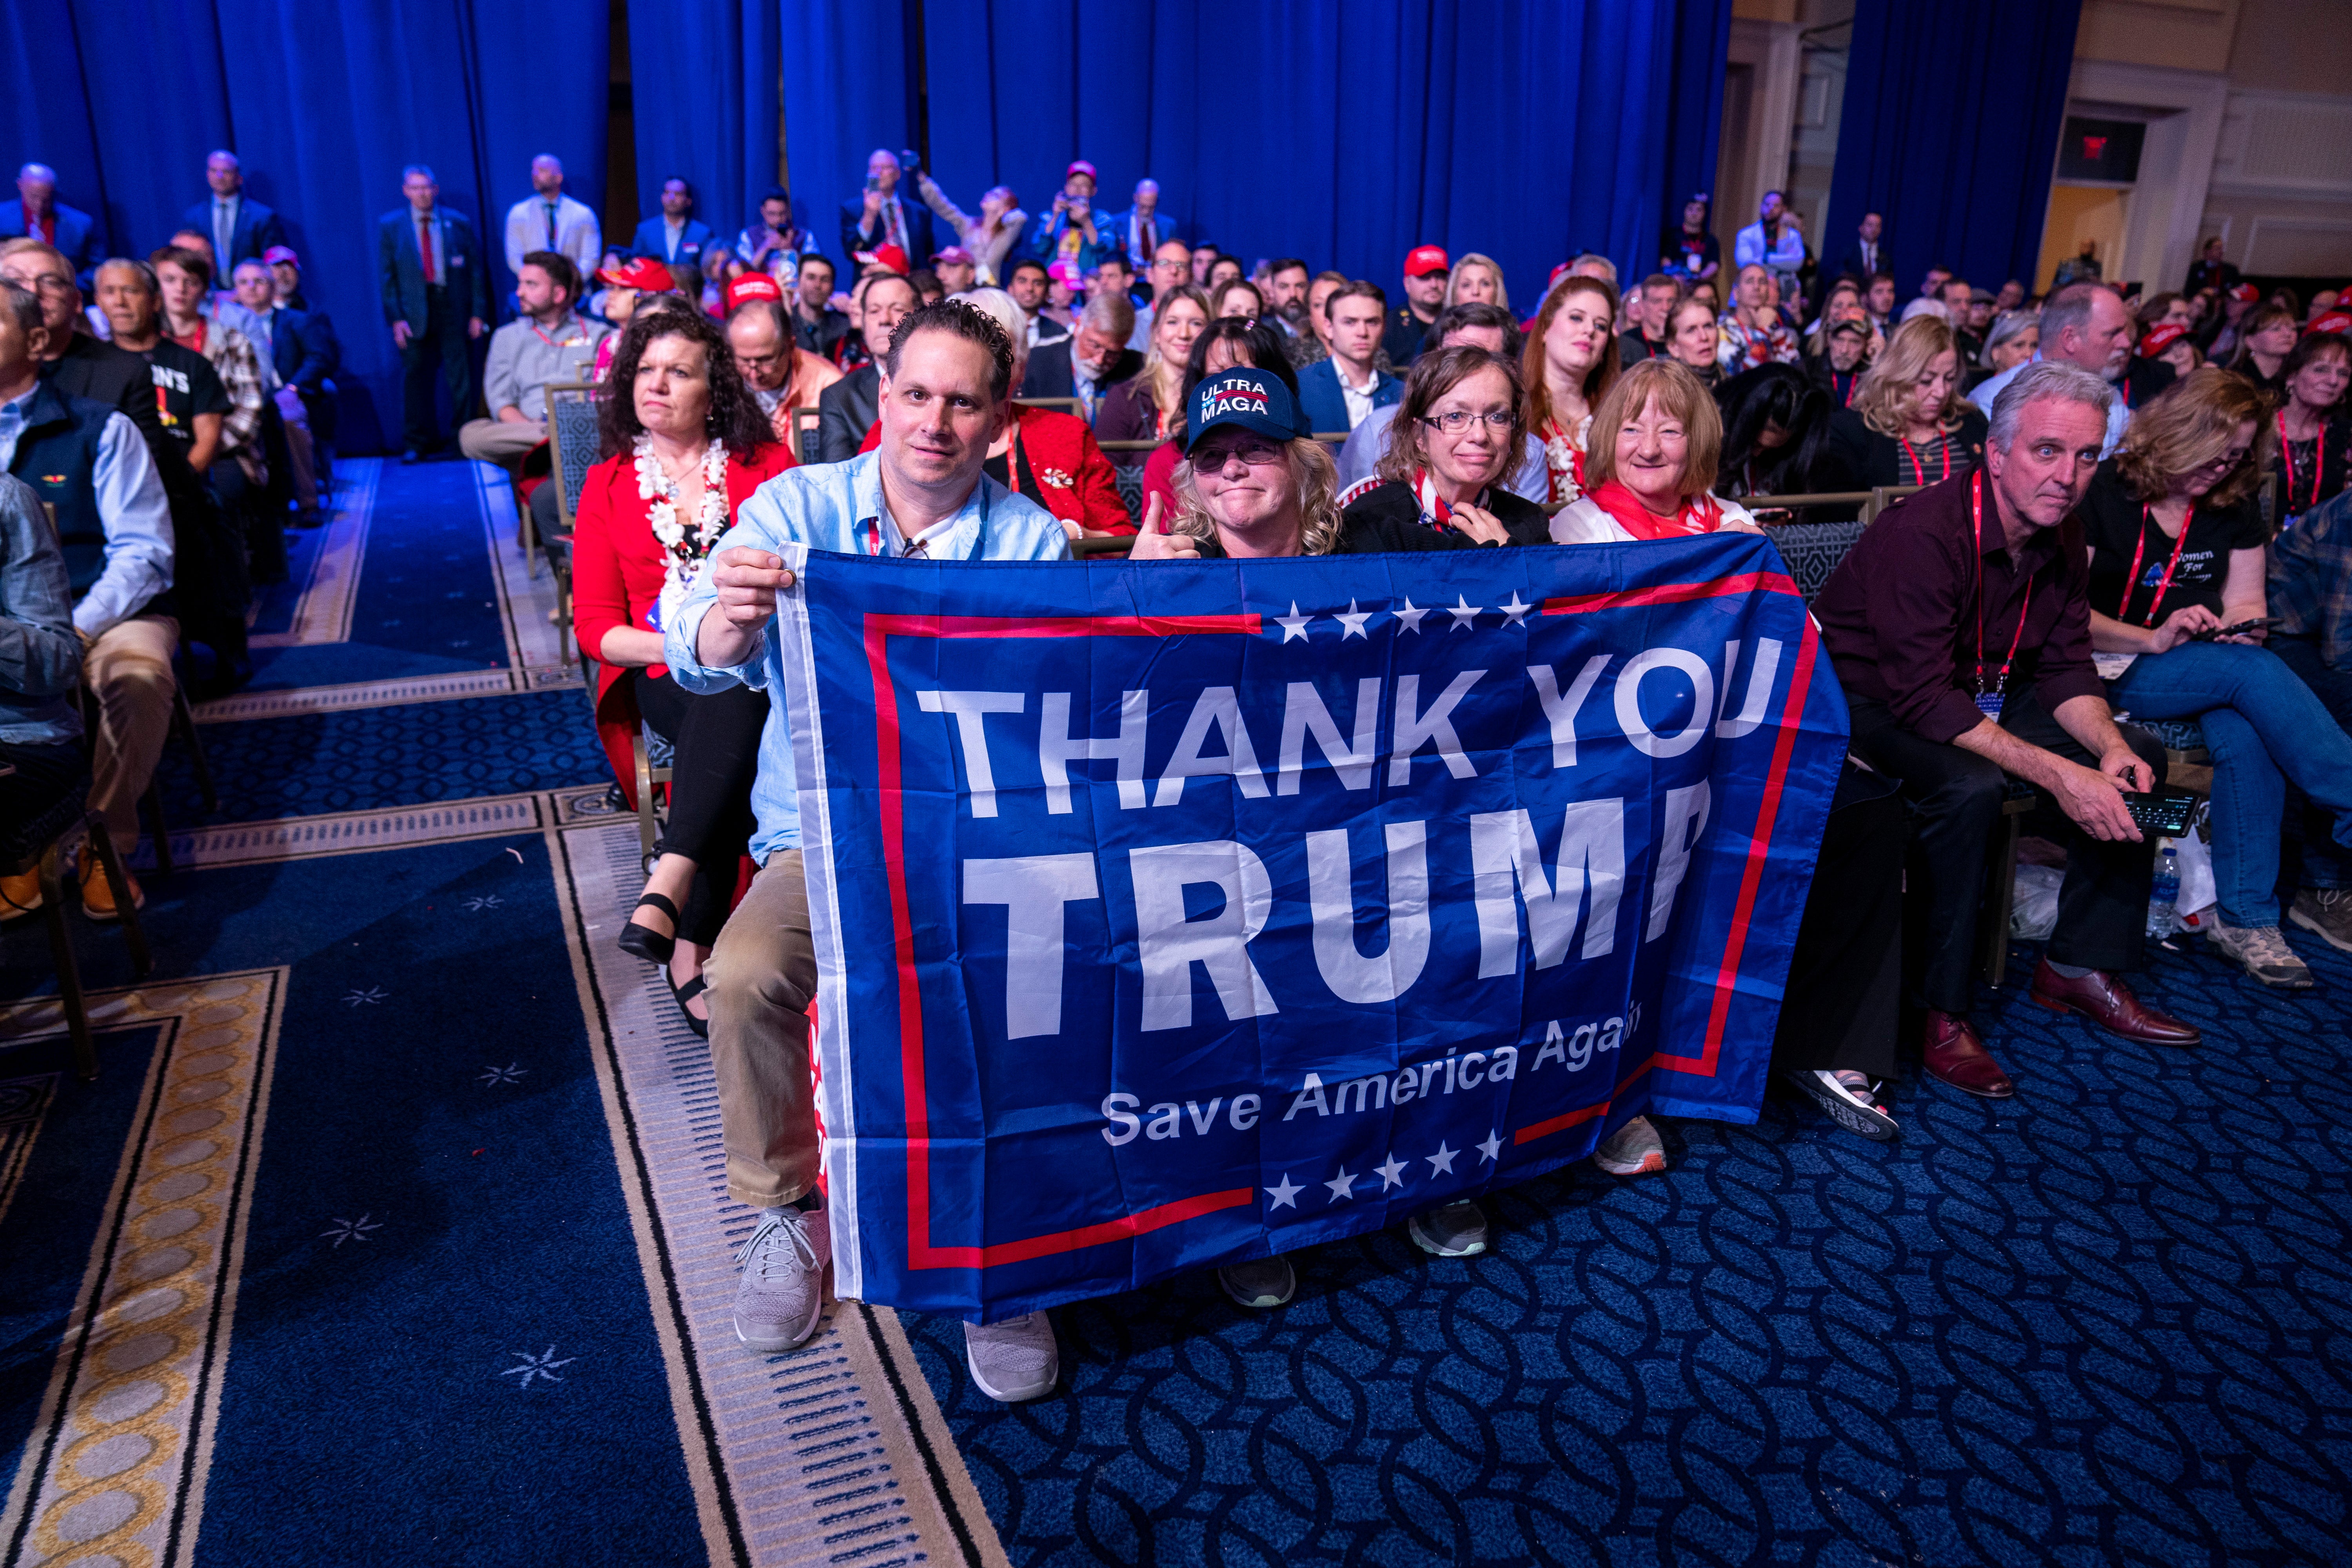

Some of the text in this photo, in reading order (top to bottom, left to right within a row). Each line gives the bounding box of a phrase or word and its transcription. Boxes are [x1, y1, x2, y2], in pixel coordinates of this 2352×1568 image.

[1201, 379, 1267, 401] ULTRA
[1201, 396, 1268, 424] MAGA
[2183, 562, 2204, 572] For
[915, 637, 1783, 819] THANK YOU
[962, 776, 1711, 1041] TRUMP
[1101, 1092, 1260, 1147] Save
[1283, 1046, 1518, 1122] America
